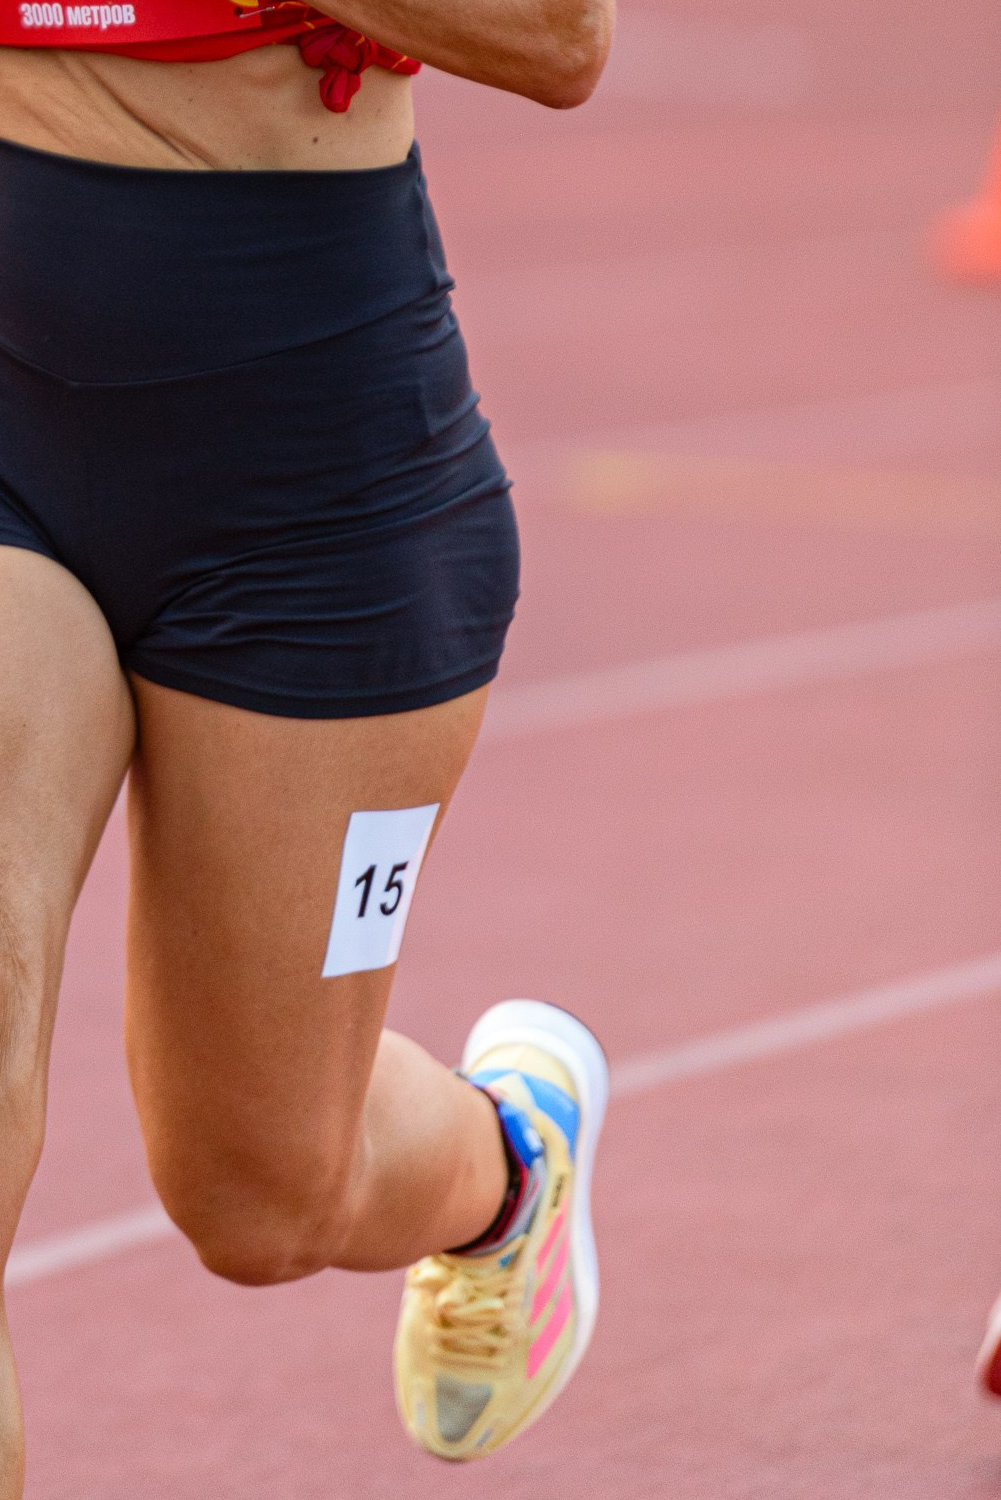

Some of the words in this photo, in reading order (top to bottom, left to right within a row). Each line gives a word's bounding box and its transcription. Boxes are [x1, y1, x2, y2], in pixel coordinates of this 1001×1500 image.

[21, 2, 64, 27] 3000
[66, 4, 136, 30] метров
[354, 860, 409, 918] 15
